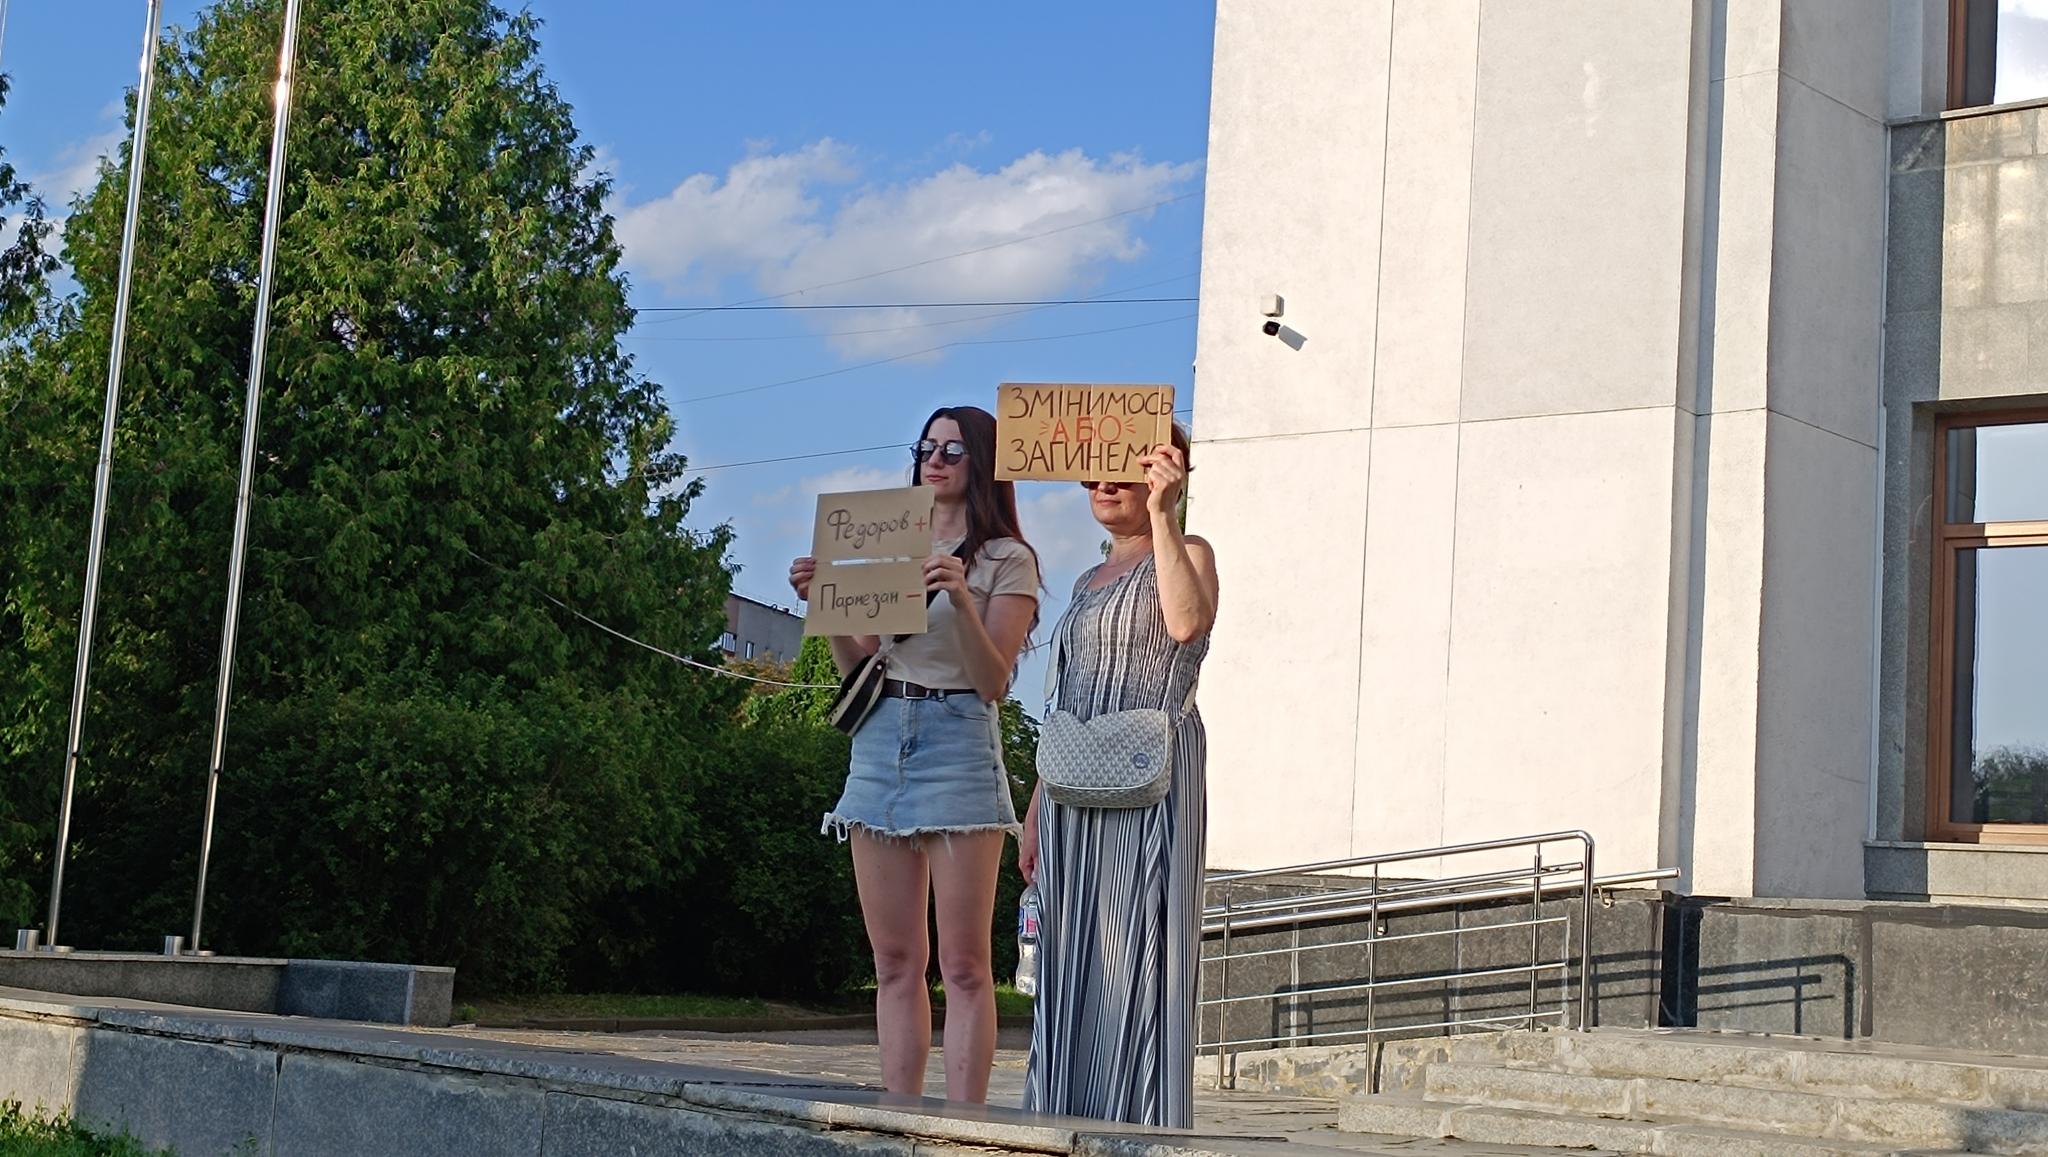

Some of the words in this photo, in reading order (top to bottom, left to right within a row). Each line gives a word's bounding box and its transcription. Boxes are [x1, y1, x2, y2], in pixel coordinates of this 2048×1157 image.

[1007, 387, 1173, 418] ЗМІНИМОСЬ
[1052, 415, 1122, 443] АБО
[827, 508, 910, 549] Федоров
